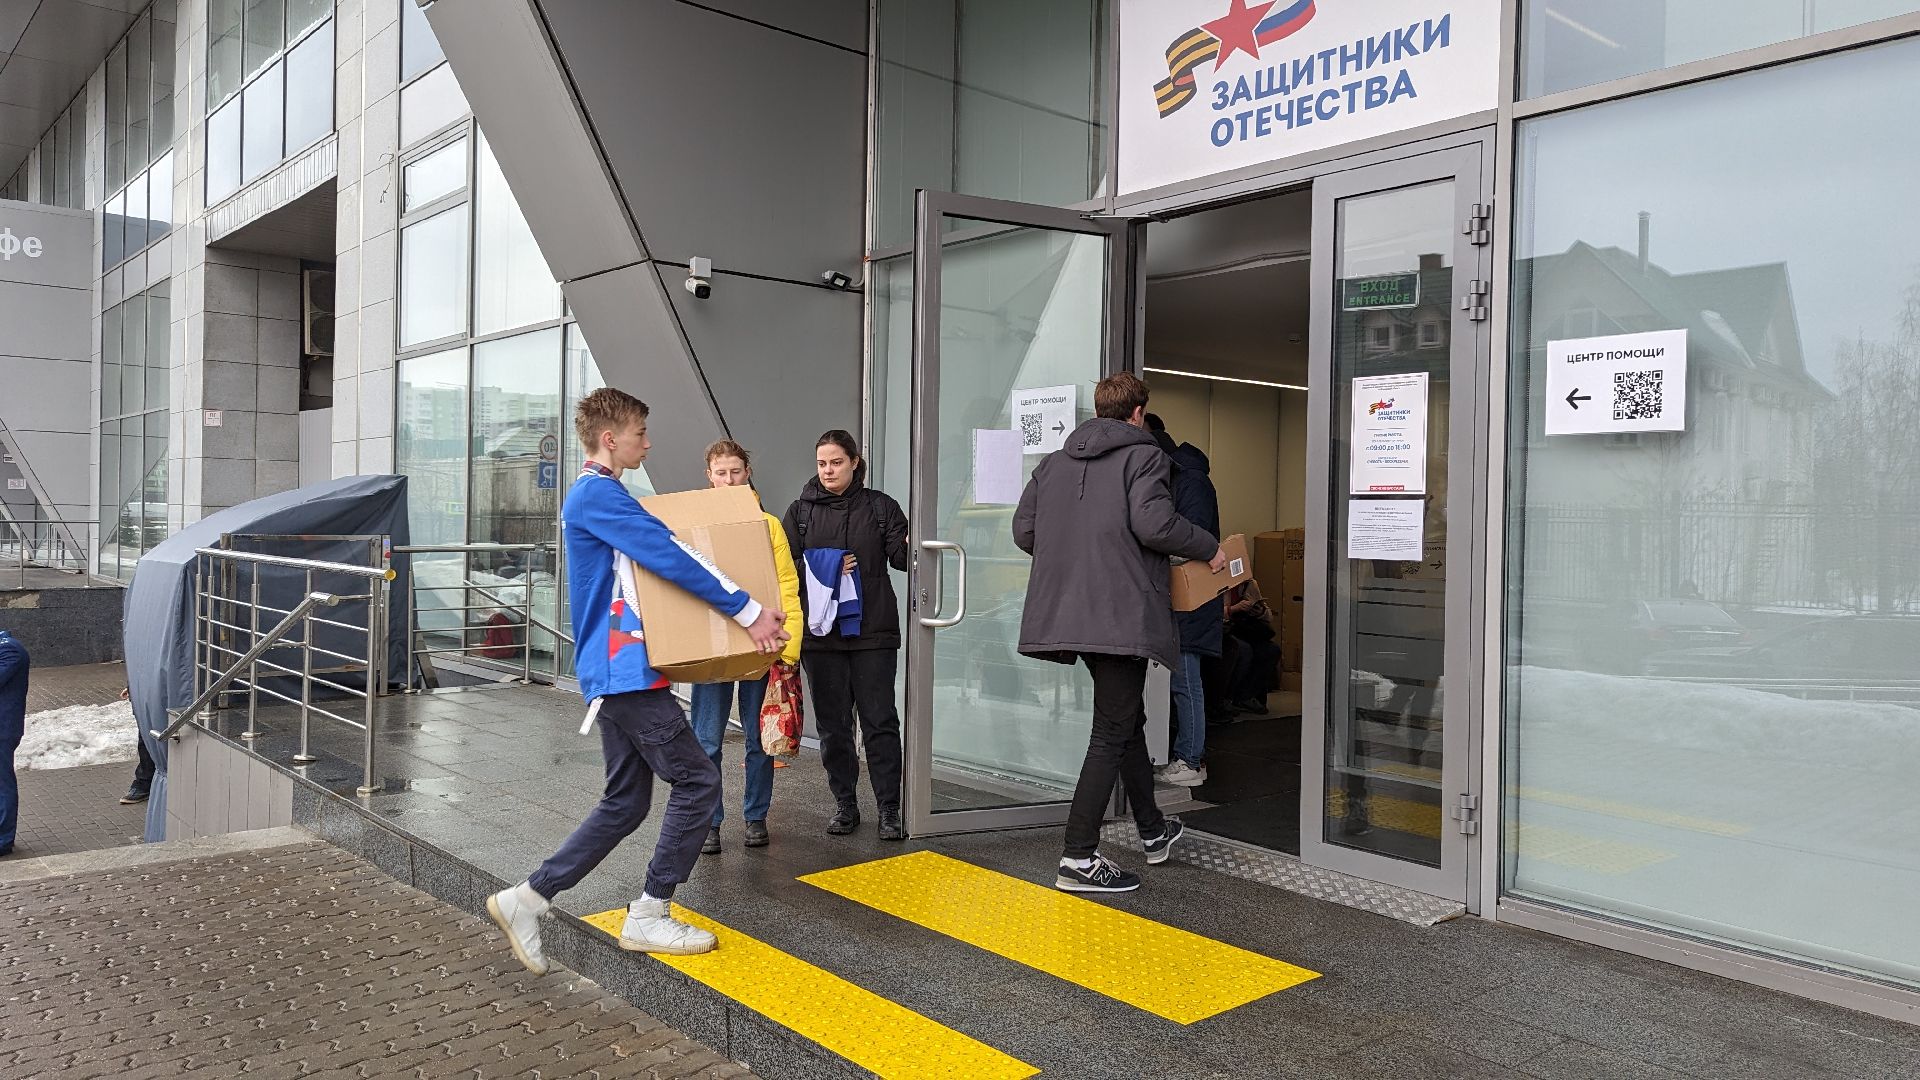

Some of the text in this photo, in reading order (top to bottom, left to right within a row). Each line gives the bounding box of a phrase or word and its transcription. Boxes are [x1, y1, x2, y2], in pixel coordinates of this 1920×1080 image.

[1211, 13, 1450, 111] ЗАЩИТНИКИ
[1210, 69, 1417, 148] ОТЕЧЕСТВА
[1360, 279, 1399, 293] ВХОД
[1349, 293, 1410, 306] ENTRANCE
[1567, 347, 1665, 364] ЦЕНТР ПОМОЩИ
[1020, 396, 1066, 406] ЦЕНТР ПОМОЩИ
